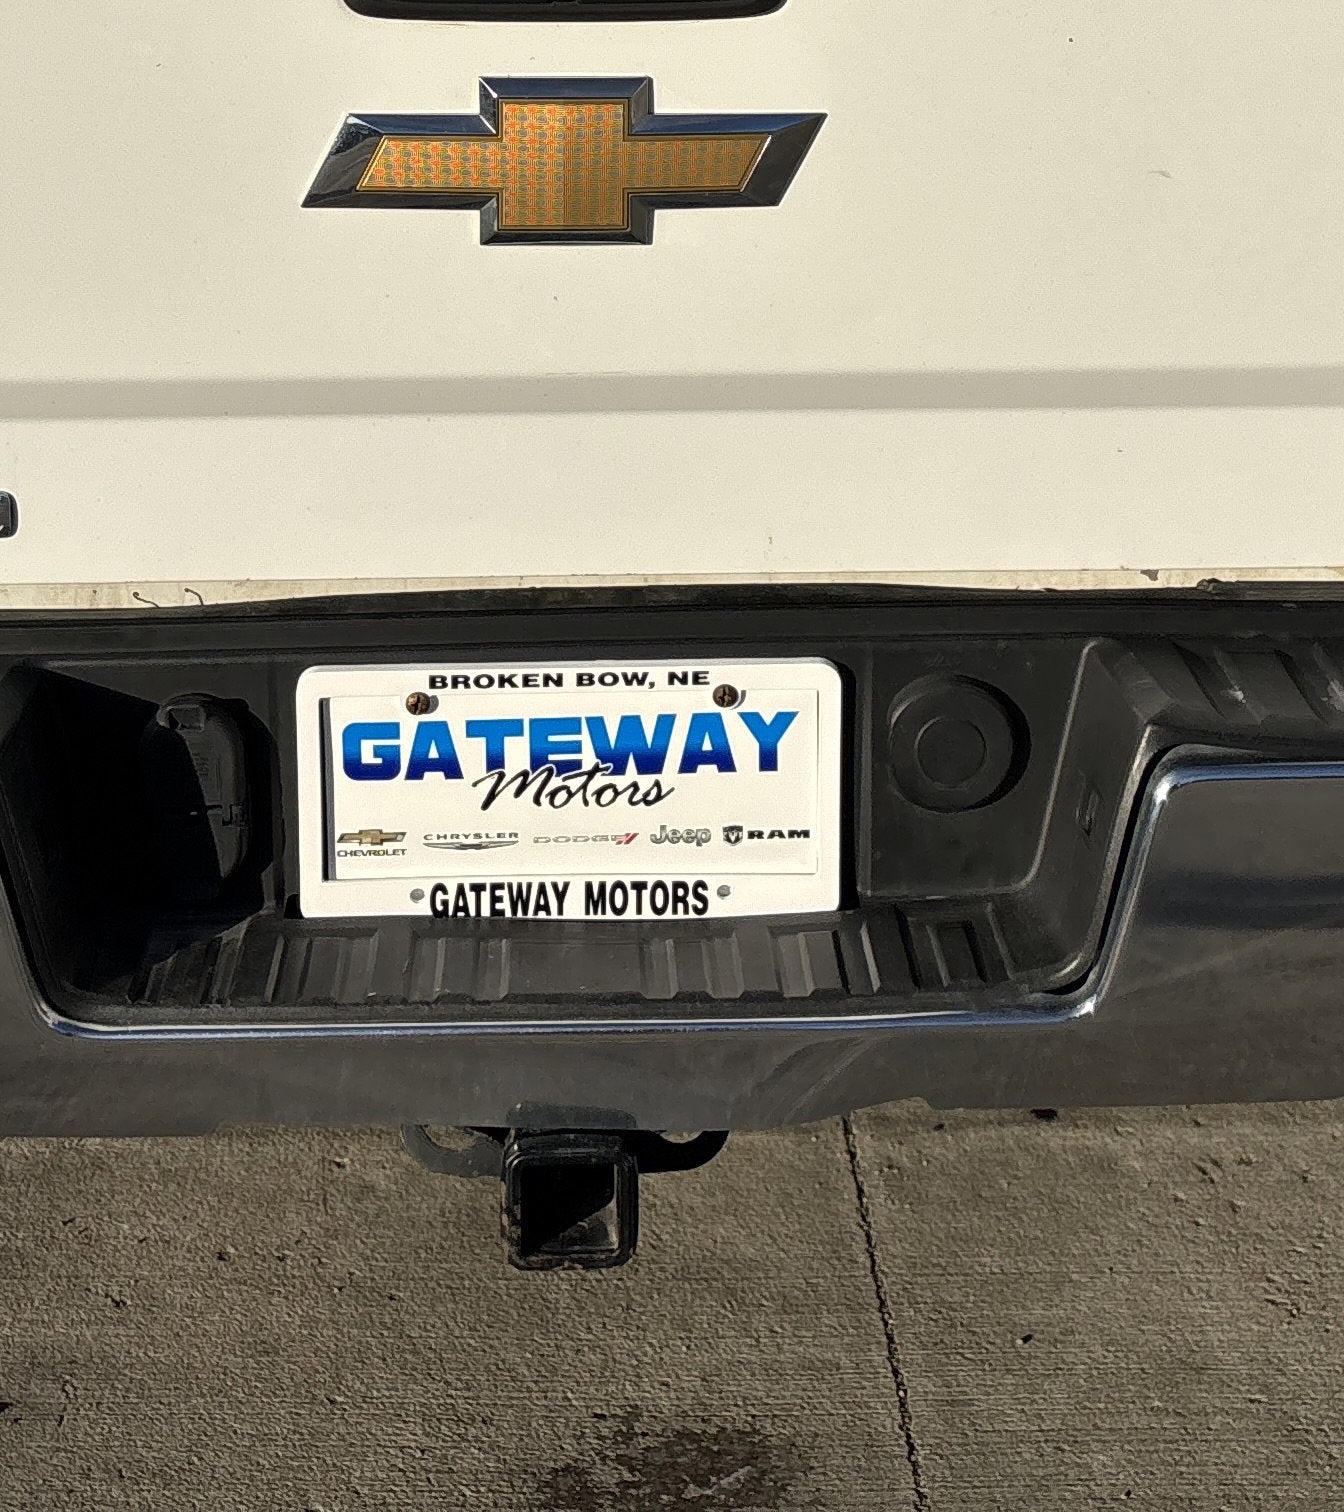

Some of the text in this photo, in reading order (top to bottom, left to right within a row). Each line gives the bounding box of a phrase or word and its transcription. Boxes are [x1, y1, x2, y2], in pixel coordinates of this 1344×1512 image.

[428, 670, 710, 690] BROKEN BOW, NE
[342, 711, 800, 781] GATEWAY
[471, 761, 675, 811] Motors
[423, 831, 519, 841] CHRYSLER
[650, 825, 711, 846] Jeep
[747, 829, 810, 839] RAM
[337, 848, 407, 858] CHEVROLET
[429, 879, 709, 919] GATEWAY MOTORS
